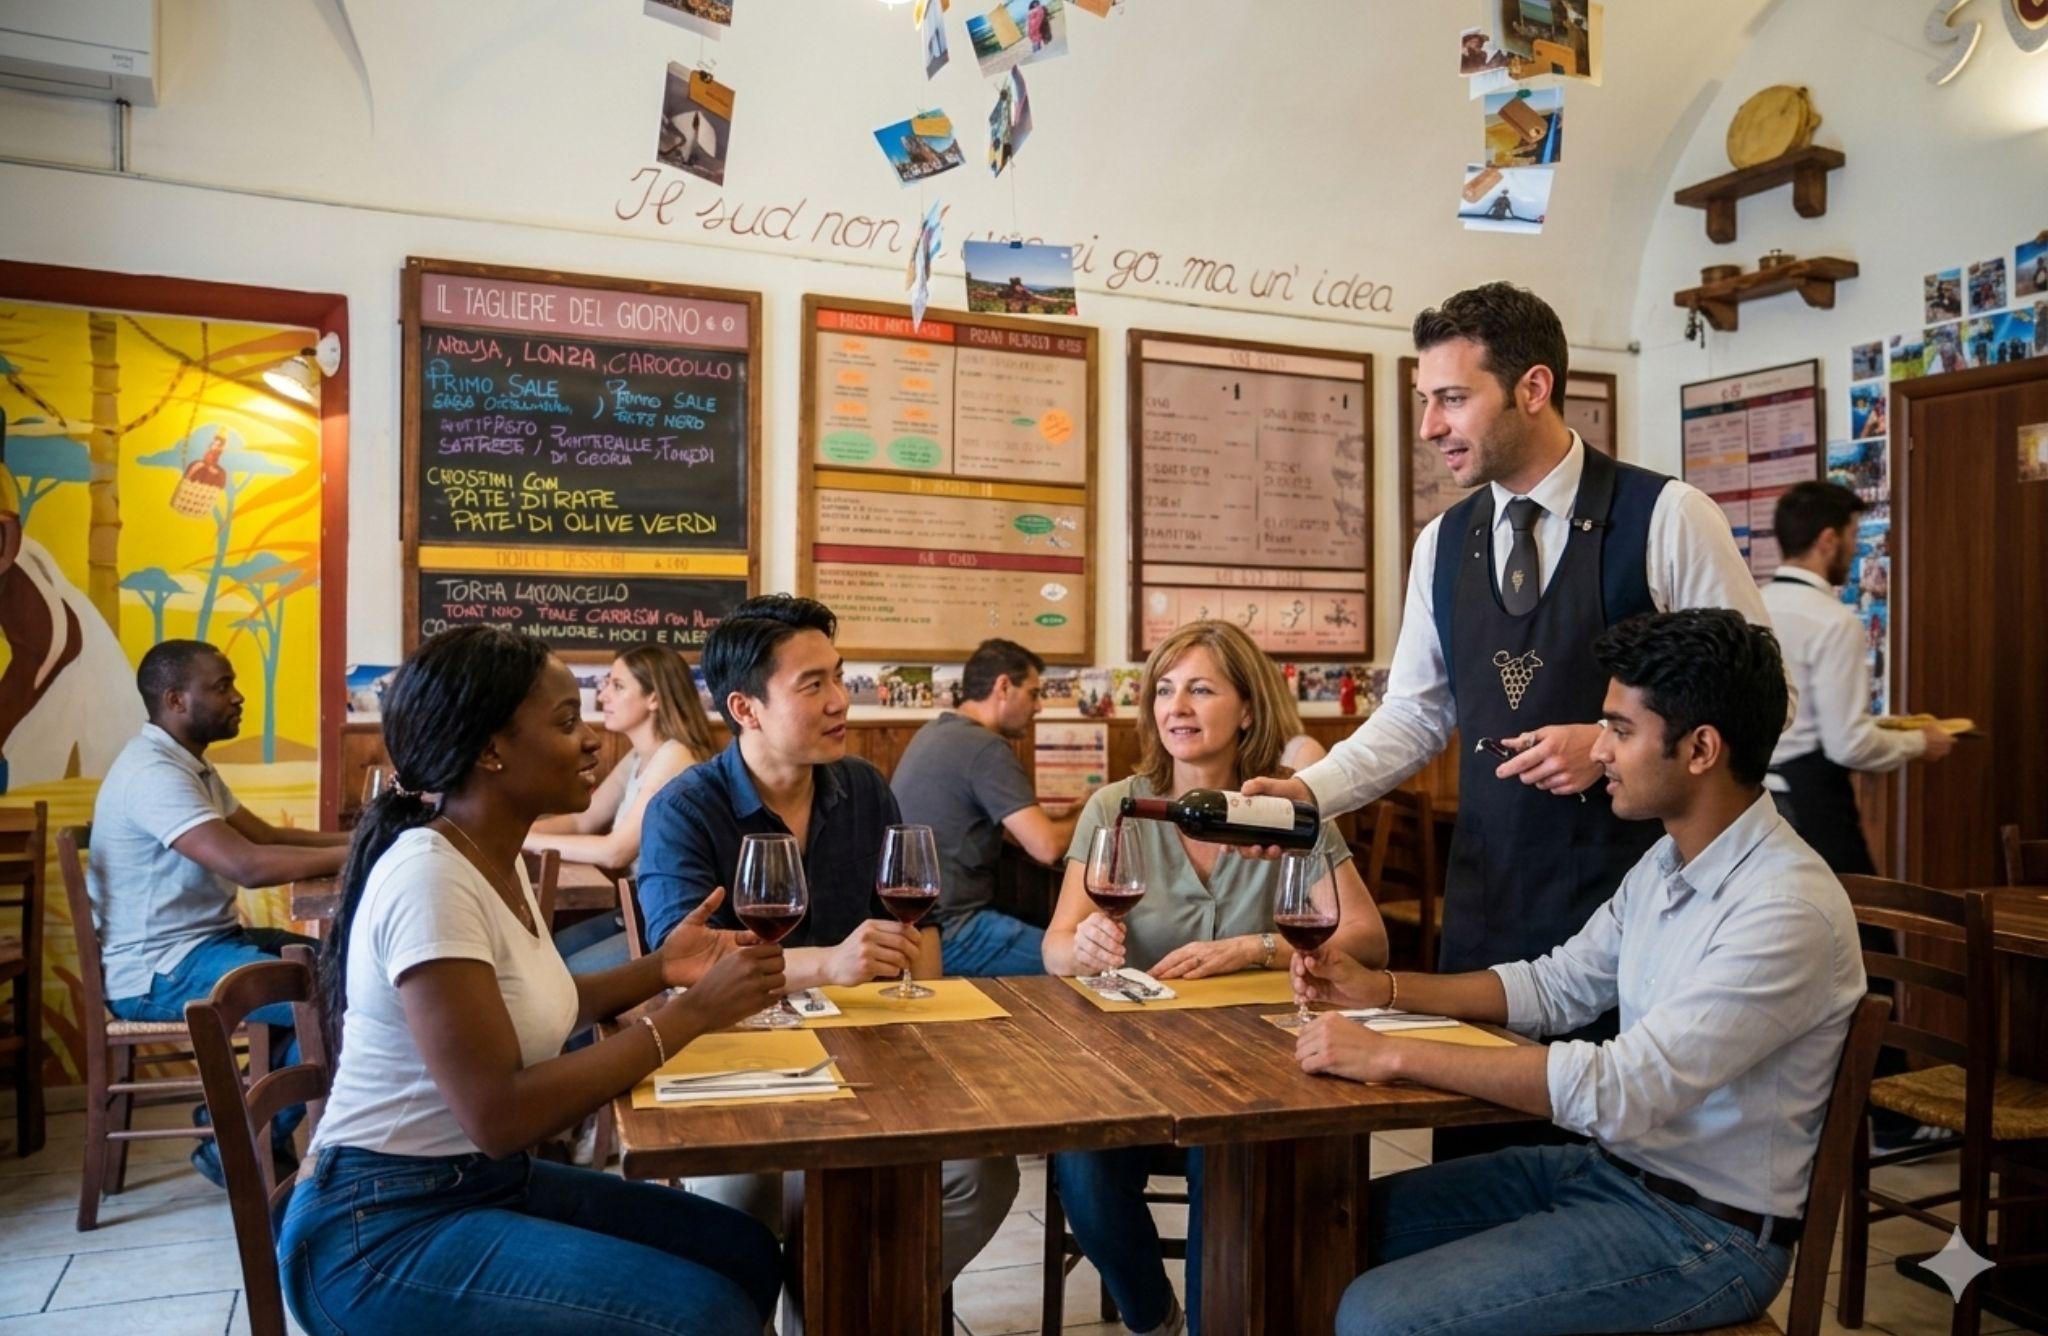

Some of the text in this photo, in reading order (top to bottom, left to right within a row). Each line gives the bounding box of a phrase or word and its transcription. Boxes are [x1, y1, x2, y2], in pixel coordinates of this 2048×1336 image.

[696, 198, 807, 241] sud
[811, 211, 902, 252] non
[1312, 269, 1394, 313] idea
[437, 284, 452, 314] IL
[463, 286, 556, 323] TAGLIERE
[569, 296, 605, 328] DEL
[617, 301, 700, 335] GIORNO
[508, 374, 559, 398] SALE
[674, 392, 717, 413] SALE
[528, 513, 554, 533] DI
[564, 512, 635, 533] OLIVE
[640, 511, 717, 535] VERDI
